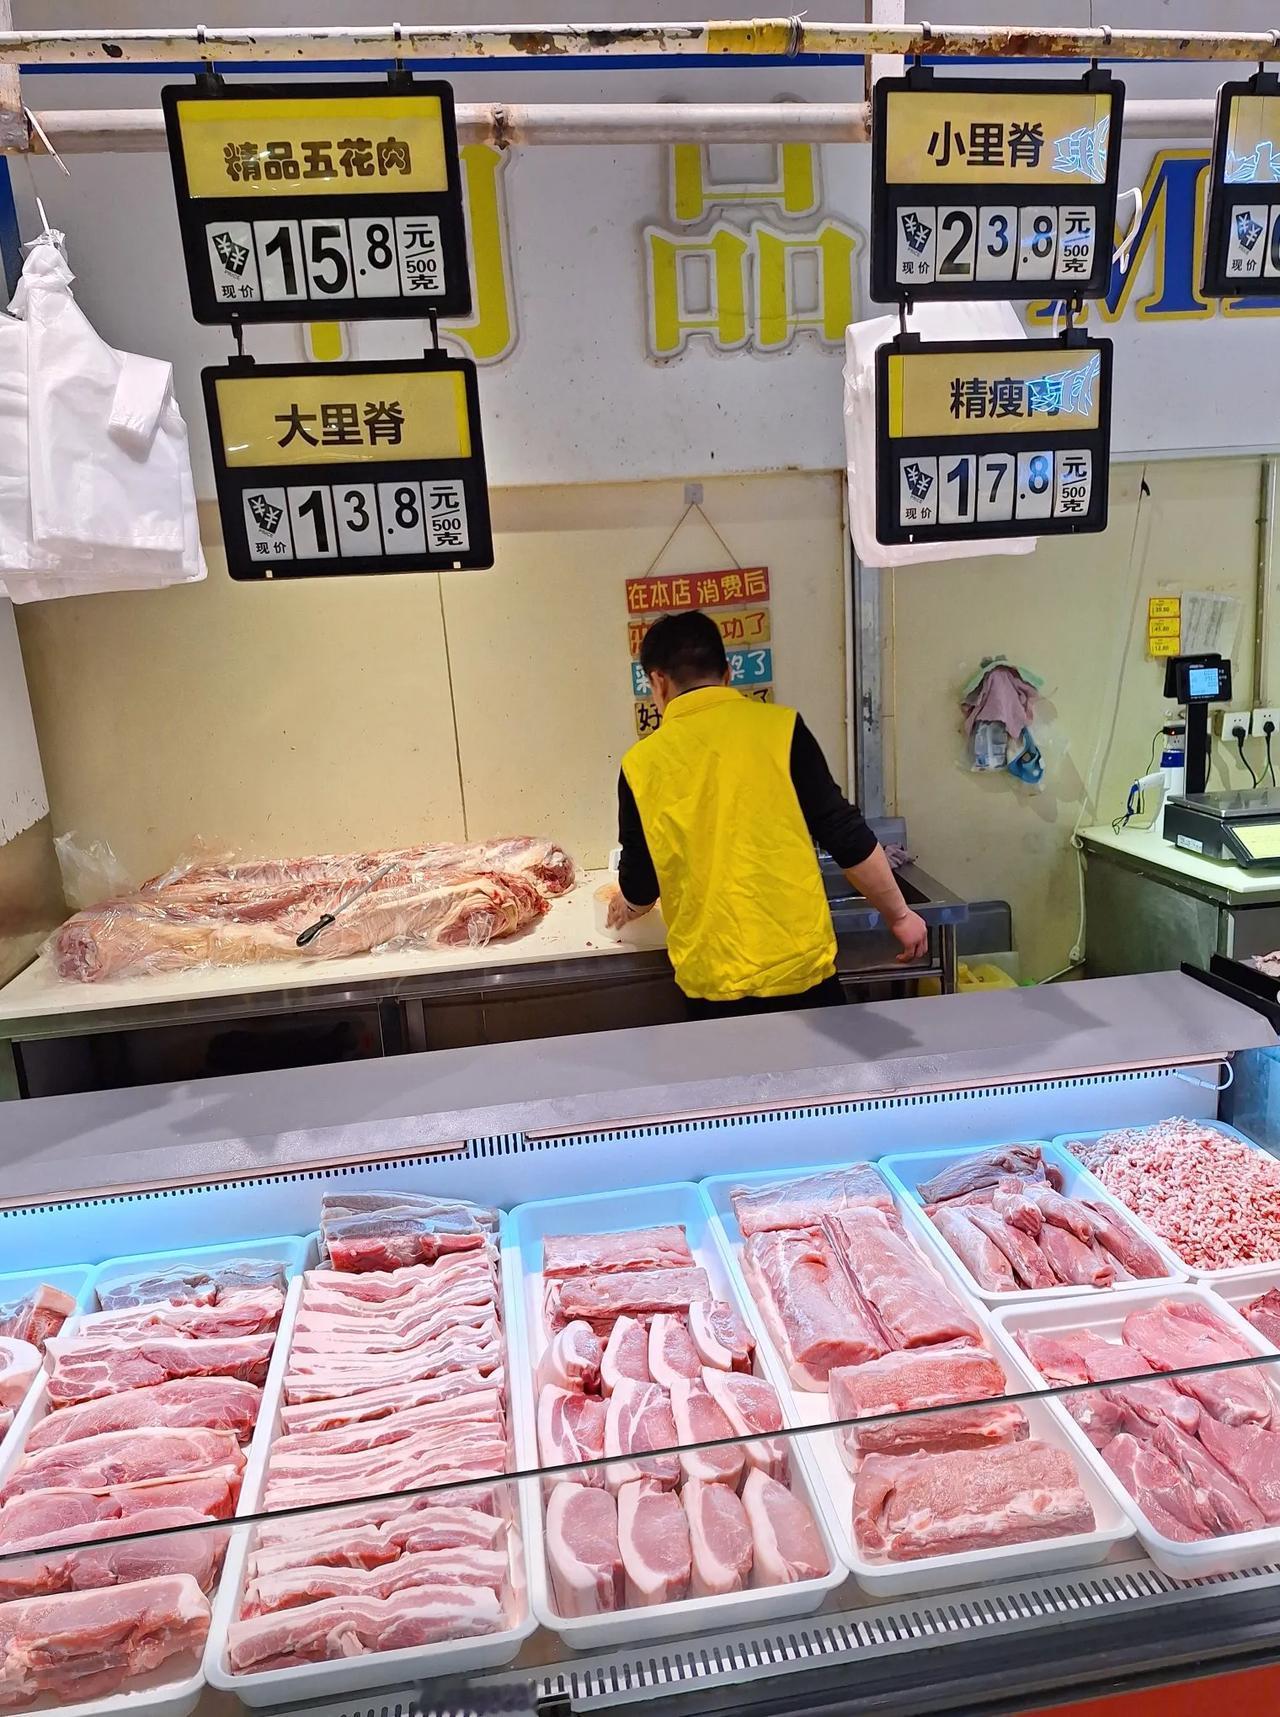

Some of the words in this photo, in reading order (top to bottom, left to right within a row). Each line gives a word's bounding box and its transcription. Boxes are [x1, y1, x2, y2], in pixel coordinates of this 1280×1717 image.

[223, 137, 410, 182] 精品五花肉
[927, 121, 1044, 167] 小里脊
[265, 223, 394, 296] 15.8
[939, 211, 1053, 276] 23.8
[1231, 259, 1257, 272] 现价
[903, 261, 930, 274] 现价
[221, 284, 254, 298] 现价
[275, 401, 405, 447] 大里脊
[947, 455, 1050, 517] 17.8
[299, 487, 419, 553] 13.8
[905, 507, 932, 520] 现价
[256, 541, 287, 554] 现价
